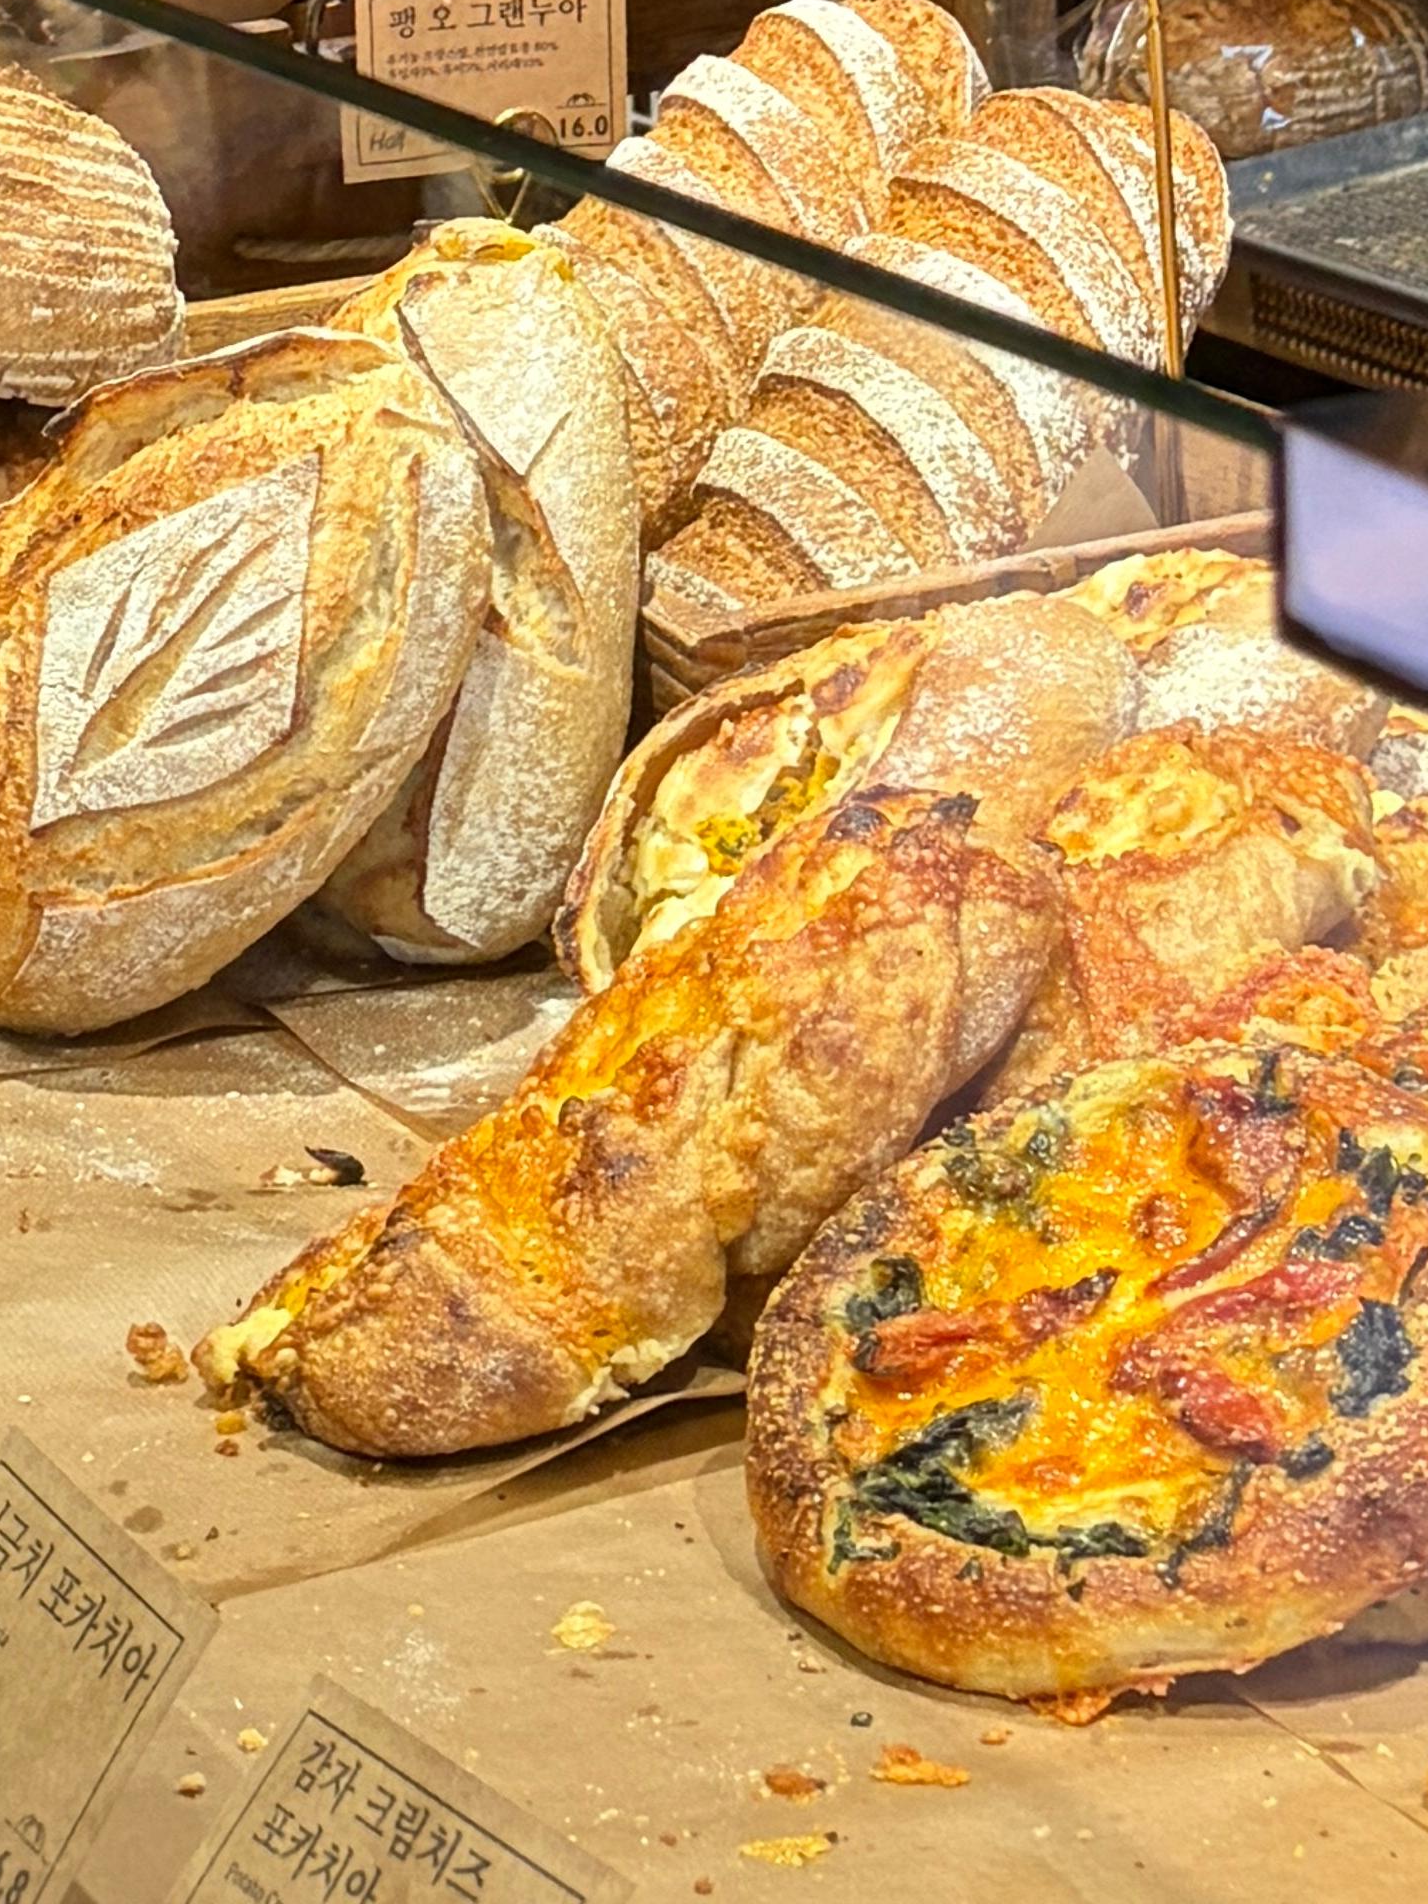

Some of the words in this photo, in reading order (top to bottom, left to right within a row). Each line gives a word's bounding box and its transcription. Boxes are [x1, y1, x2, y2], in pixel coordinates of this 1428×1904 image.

[388, 5, 416, 39] 팽
[427, 3, 457, 32] 오
[558, 113, 608, 139] 16.0
[38, 1567, 157, 1703] 포카치아
[252, 1802, 383, 1904] 포카치아
[294, 1740, 362, 1815] 감자
[354, 1784, 492, 1903] 크림치즈
